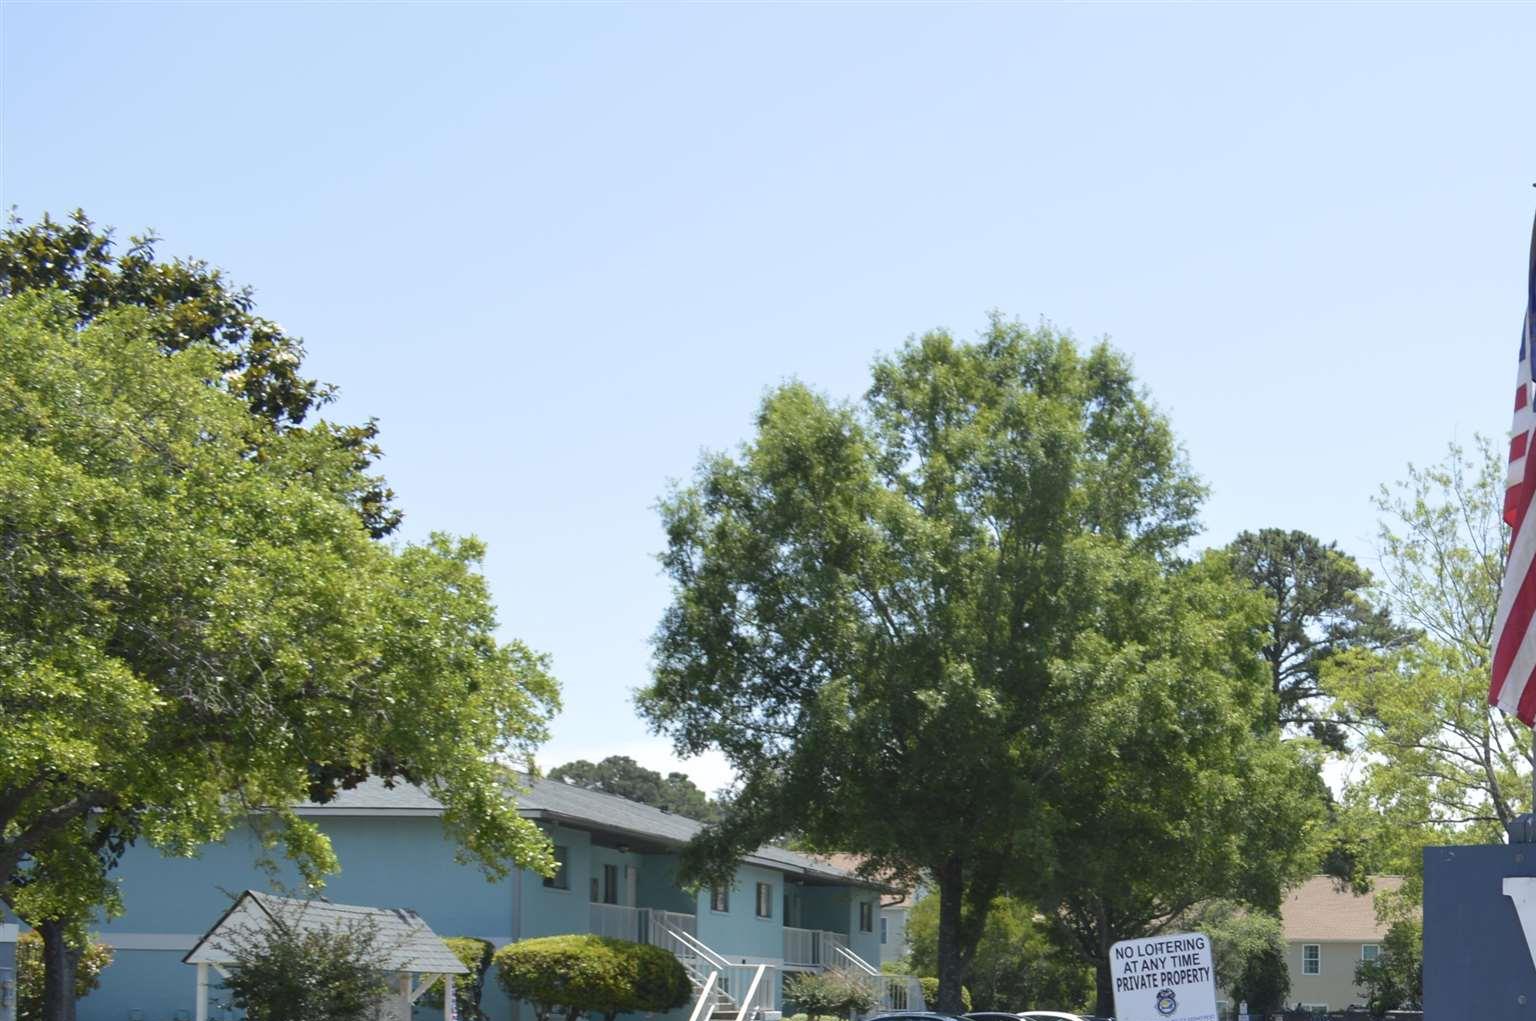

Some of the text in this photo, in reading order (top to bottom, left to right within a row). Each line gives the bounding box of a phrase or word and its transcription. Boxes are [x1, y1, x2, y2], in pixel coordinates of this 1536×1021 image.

[1116, 937, 1205, 960] NO LOITERING
[1124, 953, 1200, 974] AT ANY TIME
[1116, 967, 1210, 992] PRIVATE PROPERTY
